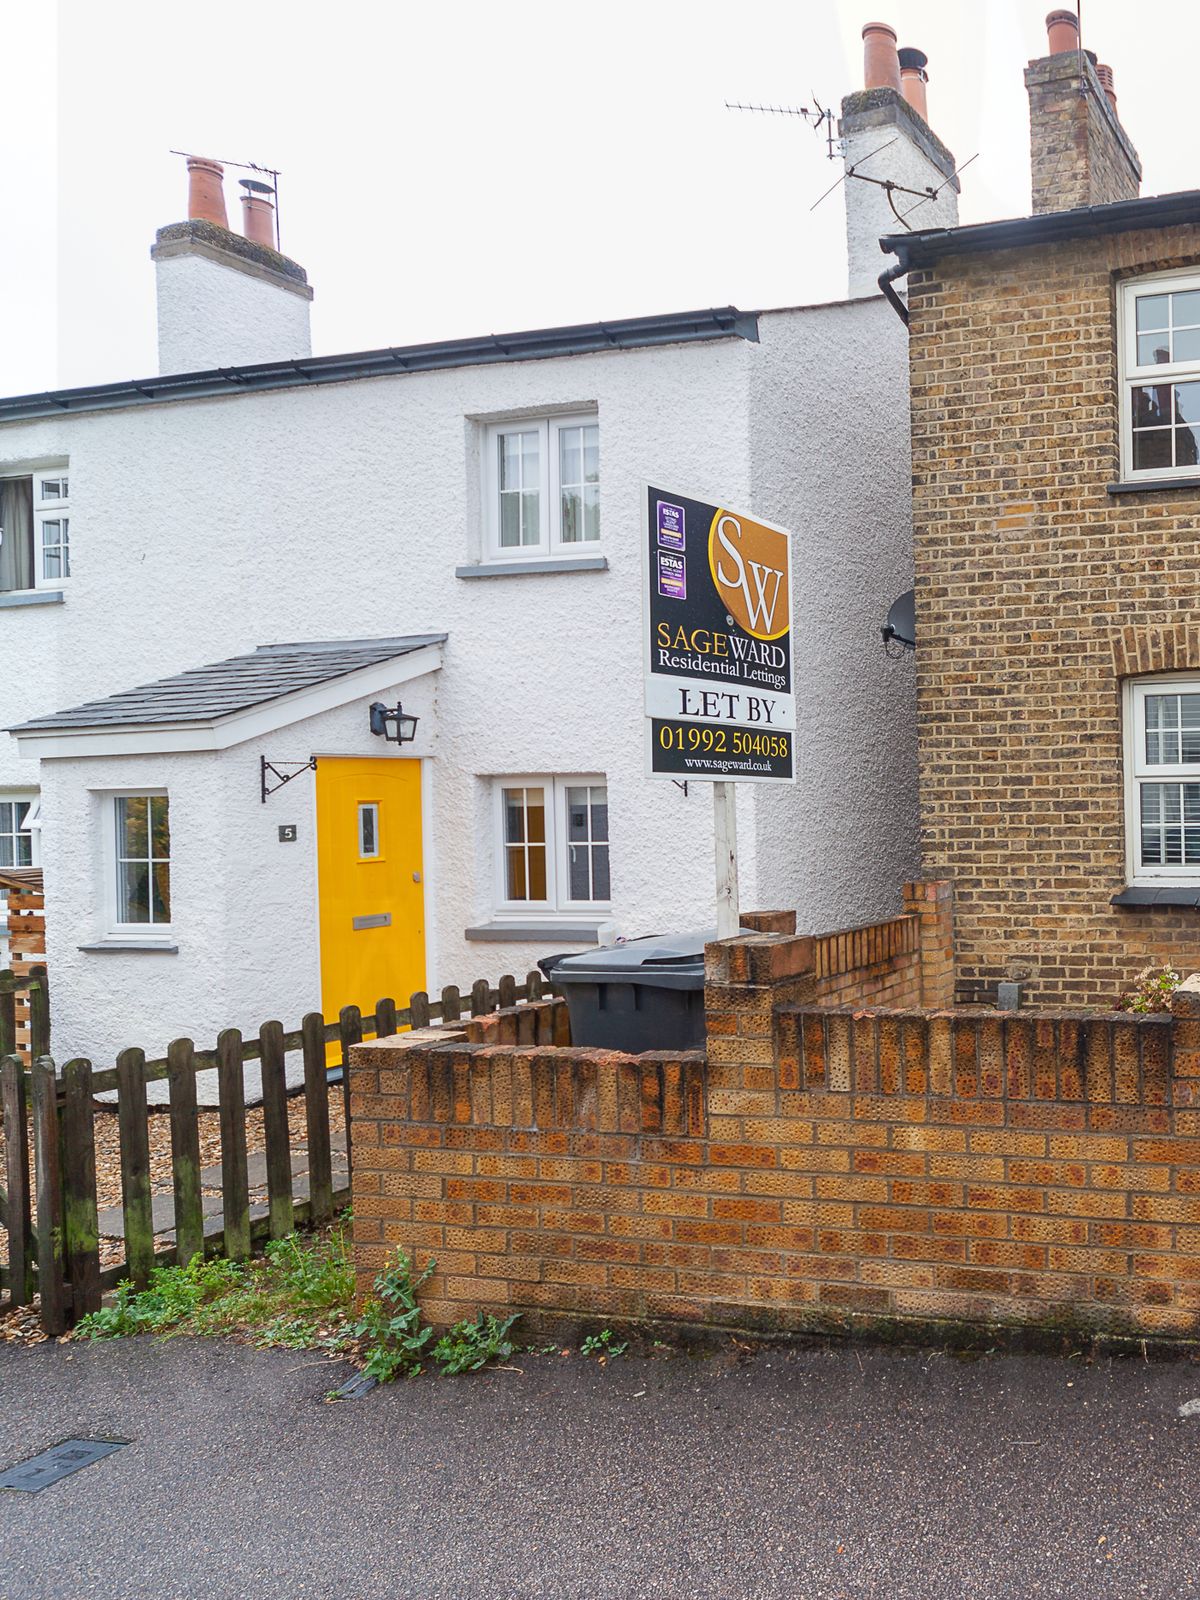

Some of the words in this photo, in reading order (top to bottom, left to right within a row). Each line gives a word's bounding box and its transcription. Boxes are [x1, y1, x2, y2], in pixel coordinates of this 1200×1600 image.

[660, 557, 683, 570] ESTAS
[717, 516, 784, 634] SW
[658, 649, 740, 677] Residential
[743, 663, 786, 690] Lettings
[678, 688, 740, 719] LET
[746, 696, 776, 724] BY
[660, 726, 727, 752] 01992
[732, 732, 788, 758] 504058
[684, 758, 772, 773] www.sageward.co.uk
[284, 828, 293, 839] 5
